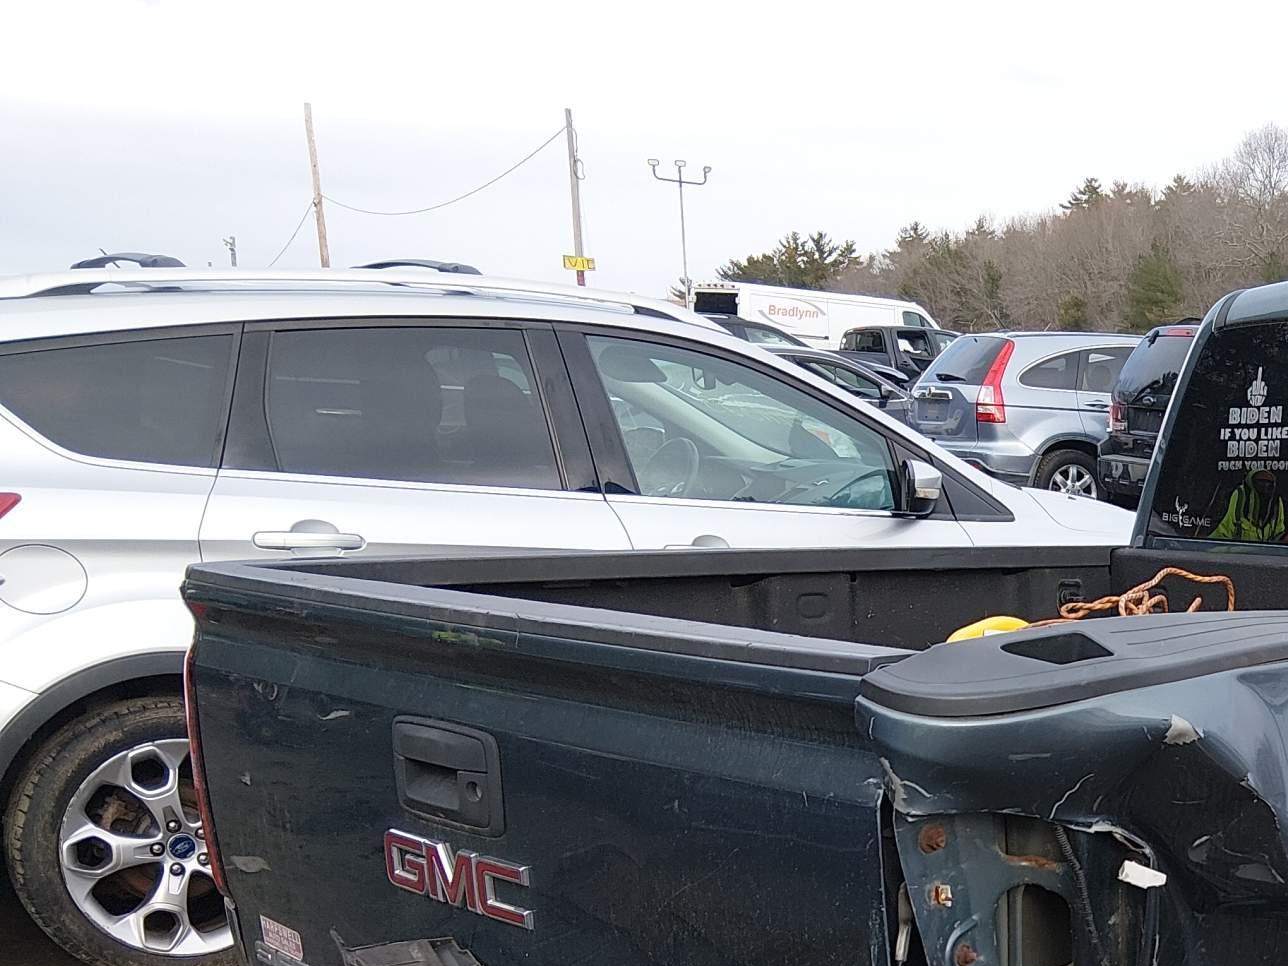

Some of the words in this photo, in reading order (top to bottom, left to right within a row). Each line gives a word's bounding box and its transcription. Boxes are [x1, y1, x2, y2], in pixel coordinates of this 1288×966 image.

[768, 304, 819, 320] Bradlynn
[1228, 405, 1283, 425] BIDEN
[1220, 428, 1231, 440] IF
[1234, 428, 1258, 440] YOU
[1260, 427, 1288, 440] LIKE
[1227, 440, 1280, 458] BIDEN
[1244, 460, 1264, 471] YOU
[1162, 512, 1179, 523] BIG
[1182, 515, 1211, 528] GAME
[384, 828, 536, 931] GMC
